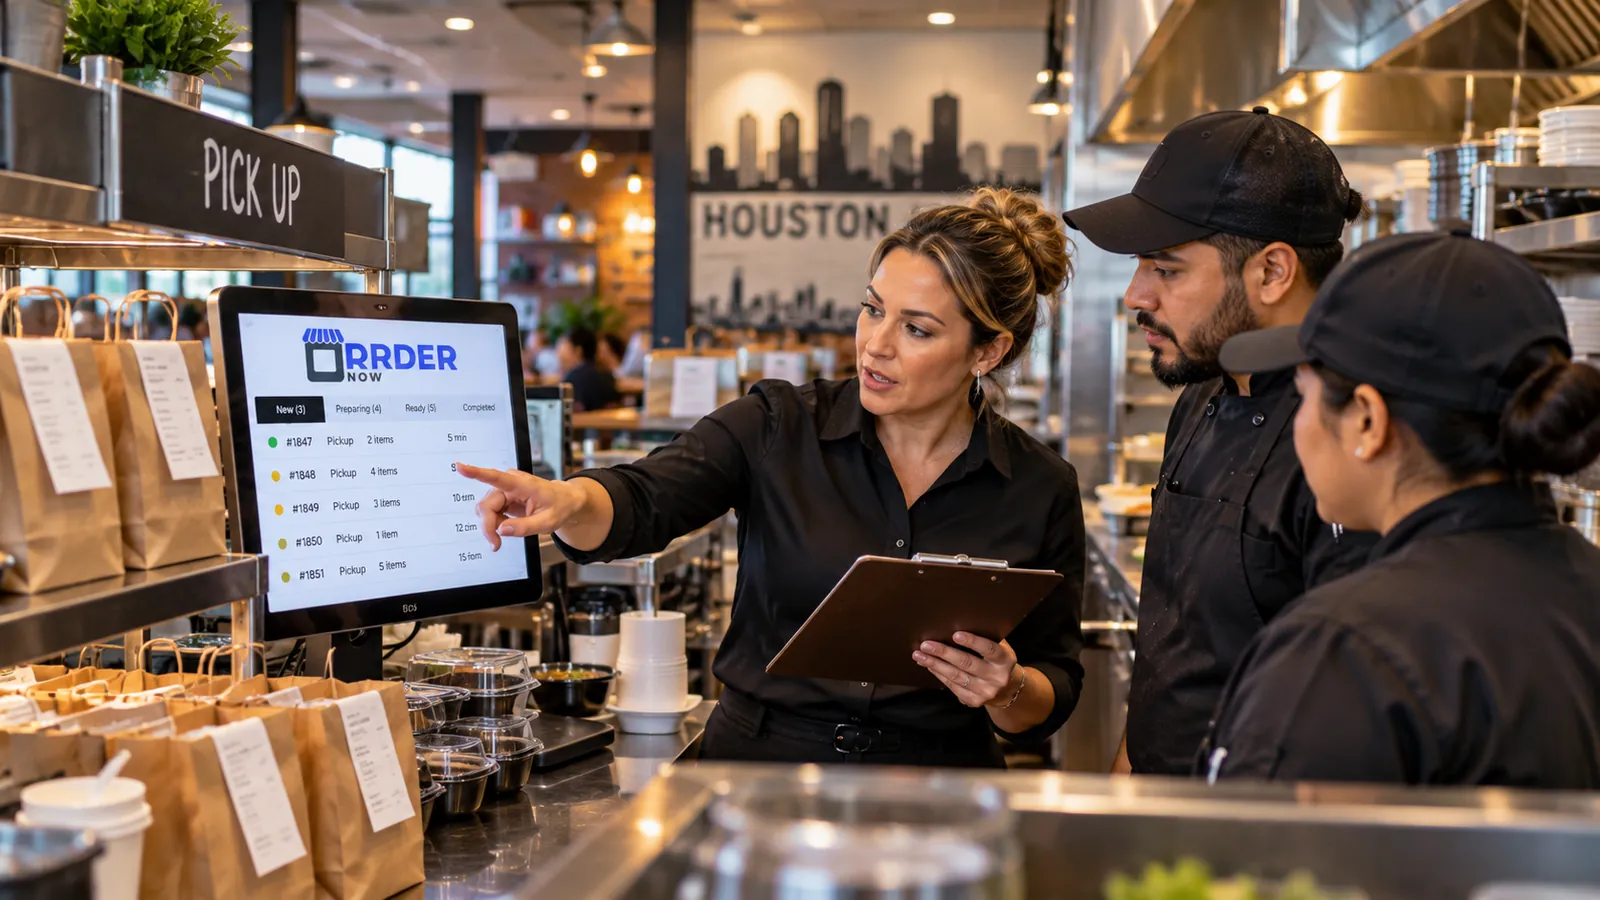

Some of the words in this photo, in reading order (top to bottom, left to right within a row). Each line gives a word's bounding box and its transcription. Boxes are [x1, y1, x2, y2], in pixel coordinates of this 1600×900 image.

[204, 138, 263, 218] PICK
[272, 163, 301, 226] UP
[703, 203, 889, 239] HOUSTON
[347, 372, 383, 382] NOW
[276, 405, 294, 414] New
[295, 404, 306, 416] (3)
[336, 404, 371, 415] Preparing
[372, 404, 382, 414] (4)
[405, 403, 426, 413] Ready
[463, 402, 496, 413] Completed
[286, 437, 313, 447] #1847
[327, 436, 354, 447] Pickup
[367, 435, 373, 444] 2
[374, 435, 394, 444] items
[447, 433, 454, 442] 5
[289, 470, 316, 480] #1848
[330, 468, 357, 479] Pickup
[370, 468, 376, 476] 4
[377, 467, 398, 476] items
[292, 503, 319, 513] #1849
[333, 501, 360, 512] Pickup
[374, 499, 379, 508] 3
[296, 537, 323, 547] #1850
[336, 533, 363, 545] Pickup
[376, 531, 380, 539] 1
[299, 569, 325, 580] #1851
[339, 566, 366, 578] Pickup
[379, 561, 384, 571] 5
[385, 561, 407, 570] items
